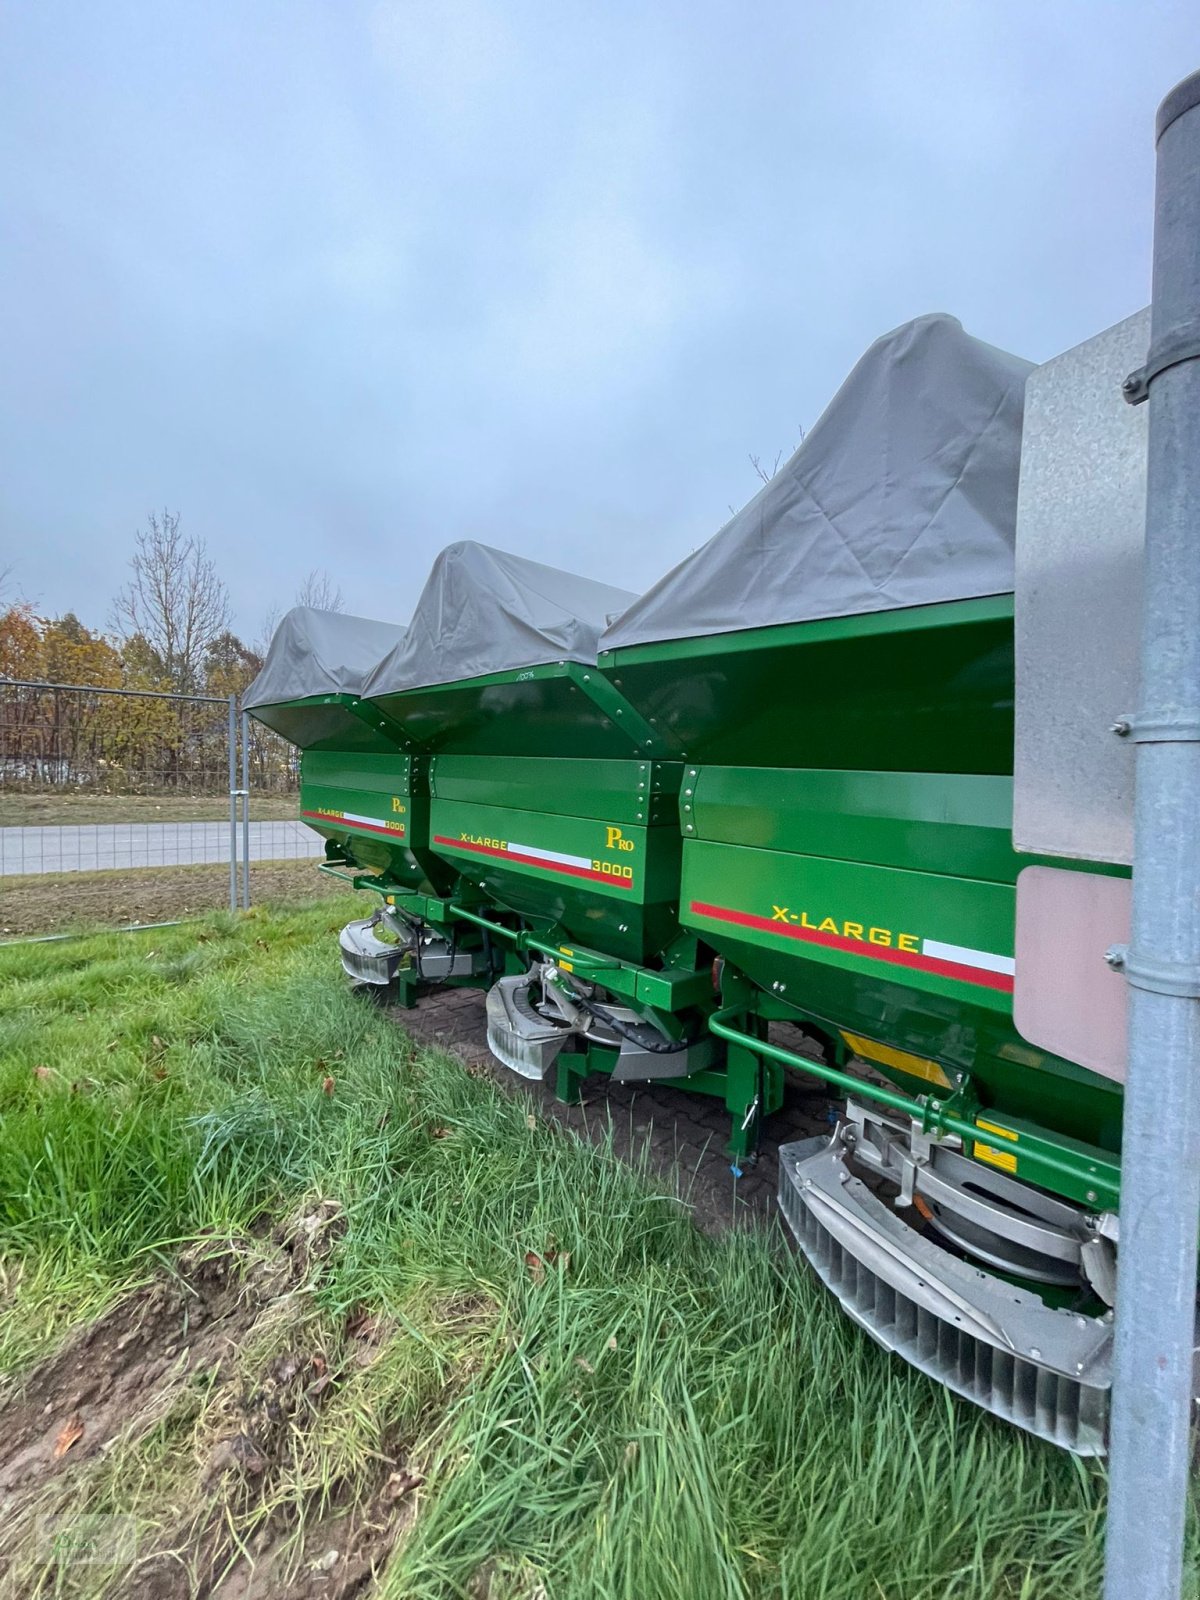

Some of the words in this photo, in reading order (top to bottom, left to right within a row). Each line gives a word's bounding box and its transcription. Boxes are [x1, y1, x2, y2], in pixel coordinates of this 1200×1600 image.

[385, 820, 405, 831] 3000
[460, 832, 507, 851] X-LARGE
[592, 860, 633, 879] 3000
[771, 905, 920, 953] X-LARGE
